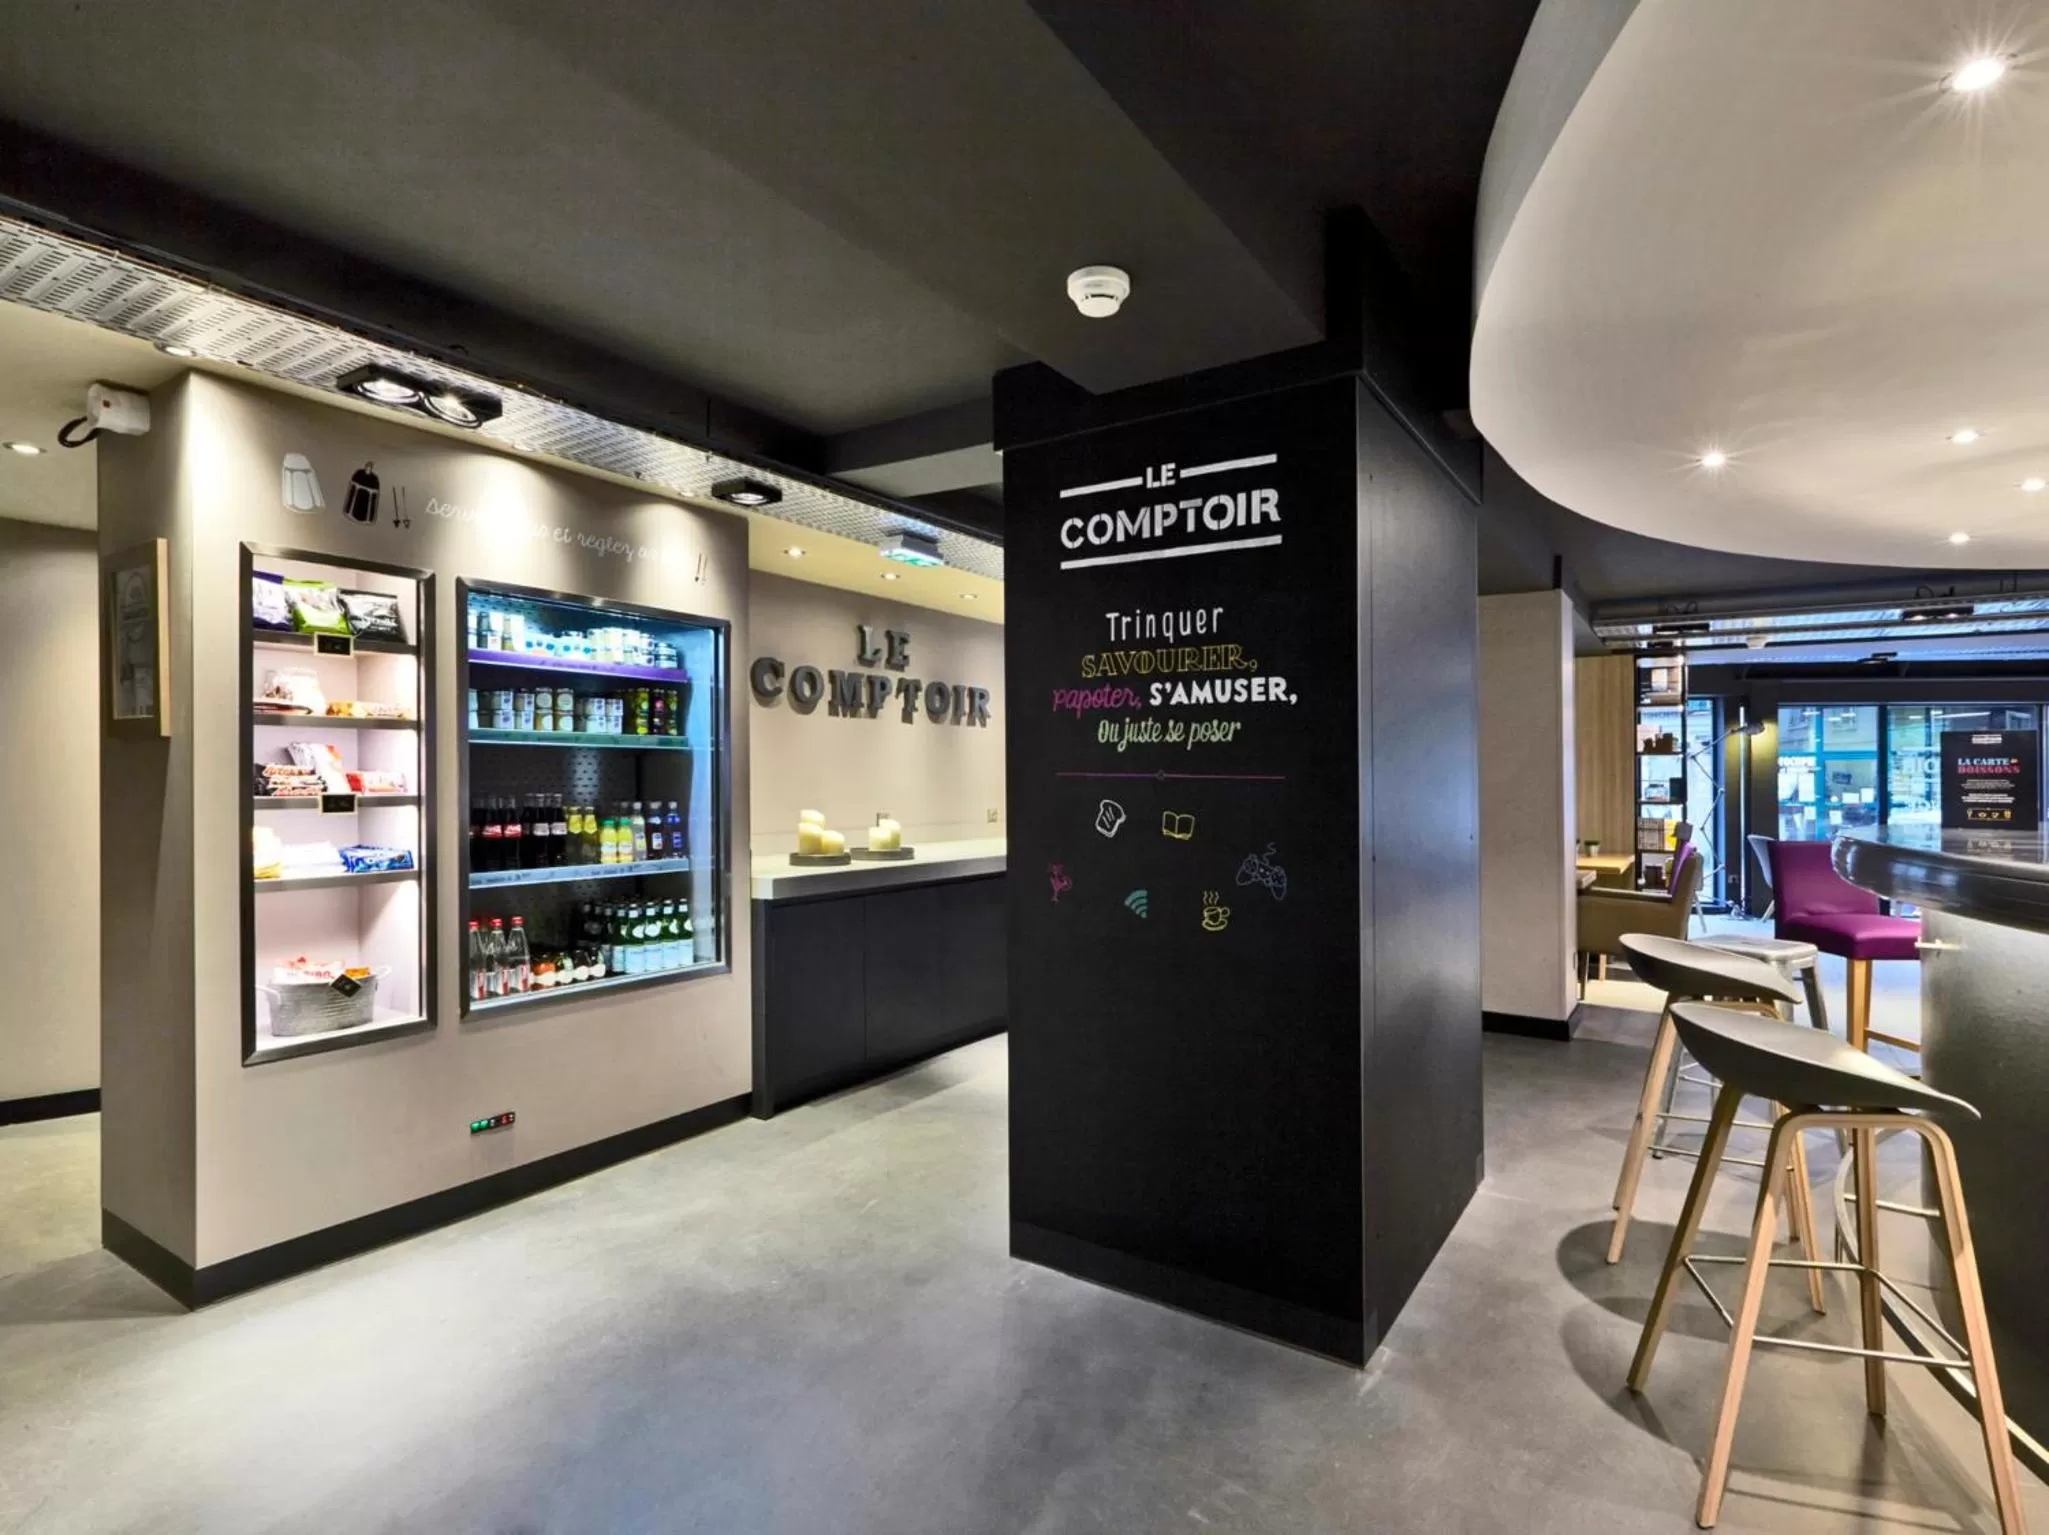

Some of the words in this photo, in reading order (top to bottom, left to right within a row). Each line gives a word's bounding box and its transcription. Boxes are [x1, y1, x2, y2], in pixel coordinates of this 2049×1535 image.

[1146, 463, 1176, 489] LE
[1060, 488, 1281, 549] COMPTOIR
[1105, 607, 1224, 643] Trinquer
[857, 624, 912, 672] LE
[1081, 644, 1258, 678] SAVOURER,
[750, 656, 991, 727] COMPTOIR
[1052, 683, 1142, 719] papoter,
[1149, 676, 1298, 706] S'AMUSER,
[1097, 719, 1119, 743] Ou
[1117, 717, 1162, 752] juste
[1164, 719, 1185, 742] se
[1187, 719, 1242, 750] poser
